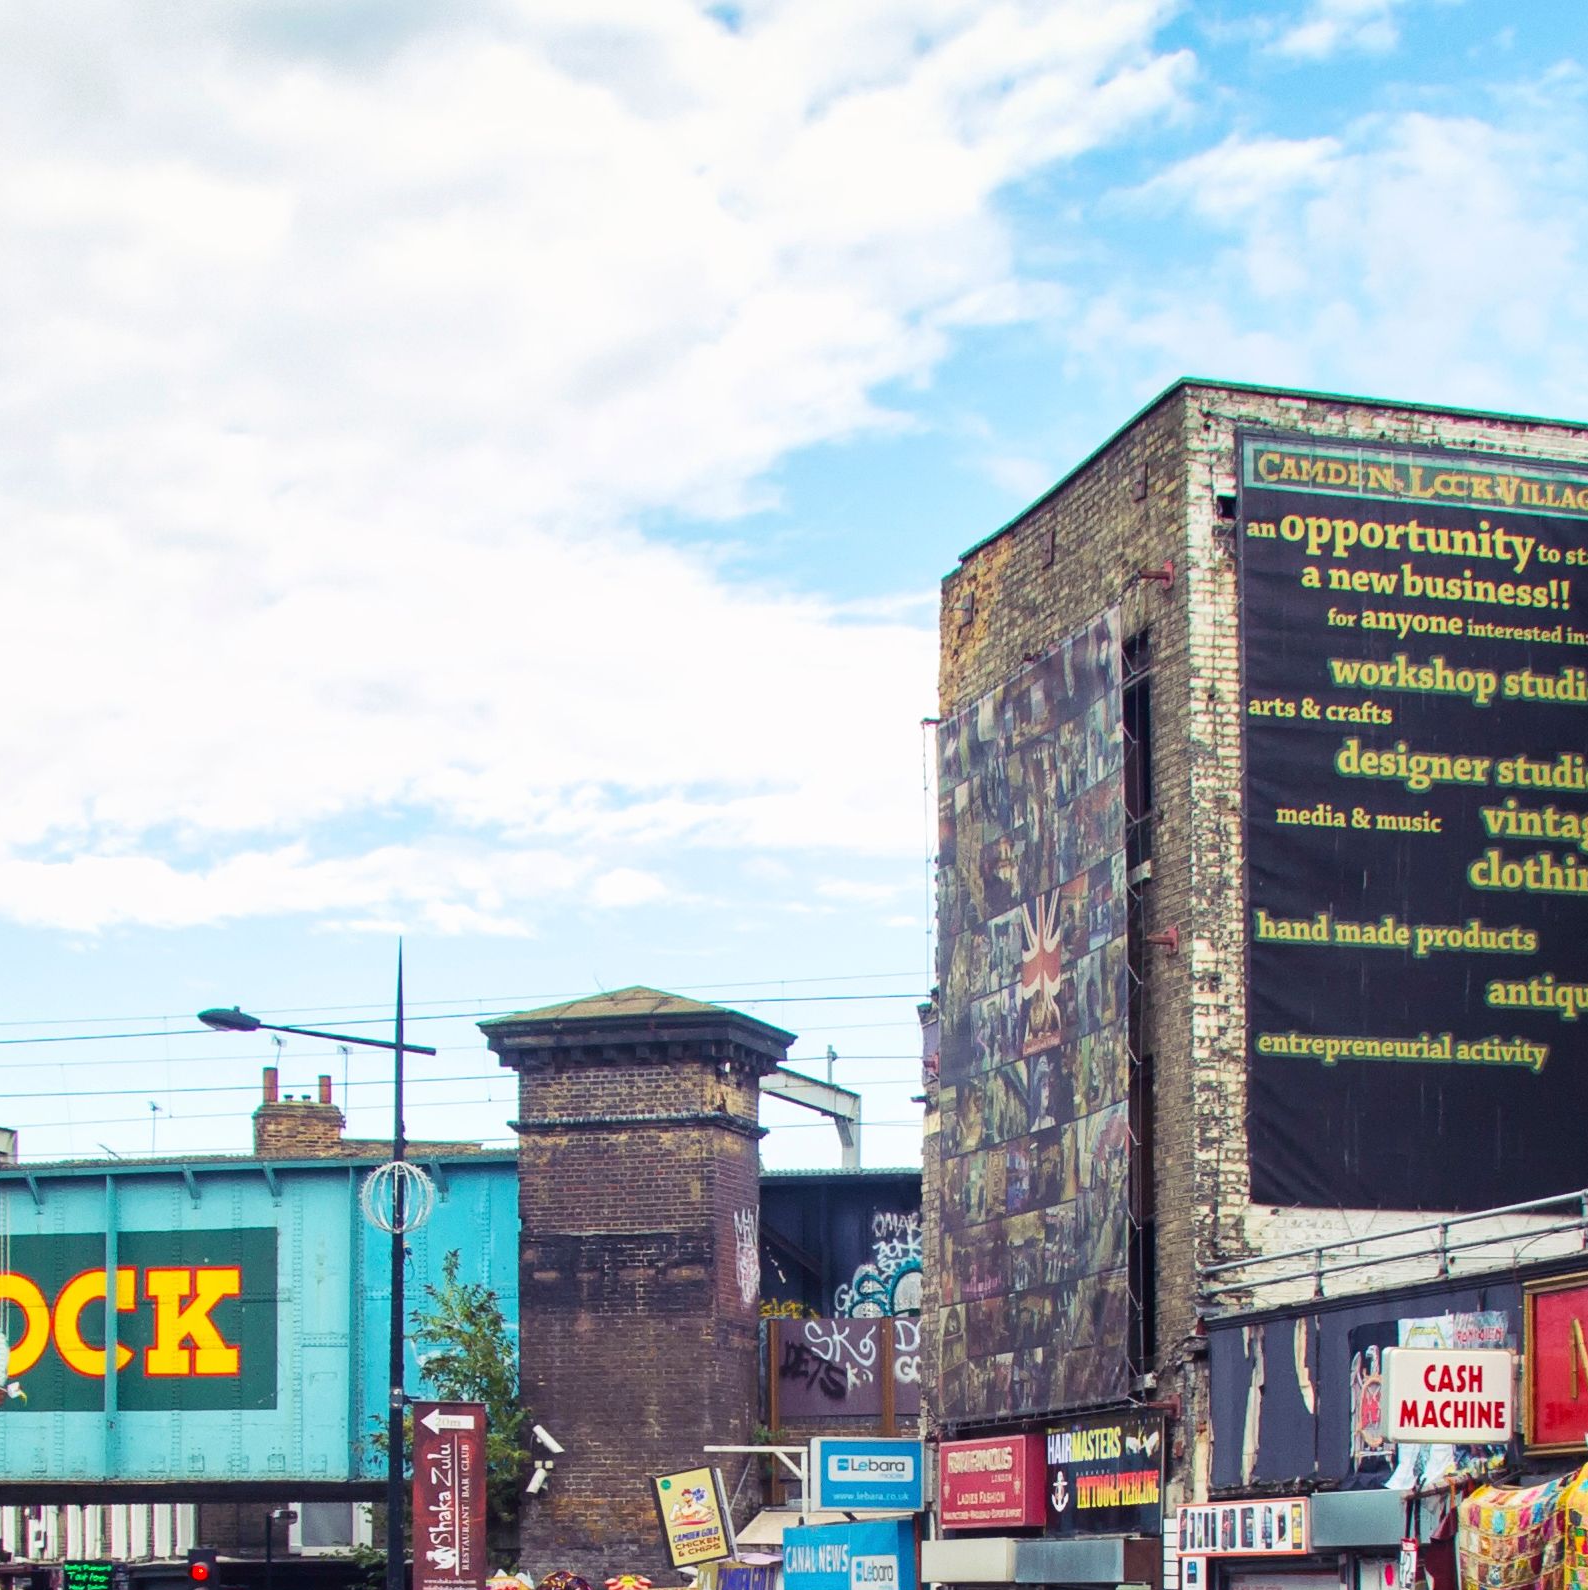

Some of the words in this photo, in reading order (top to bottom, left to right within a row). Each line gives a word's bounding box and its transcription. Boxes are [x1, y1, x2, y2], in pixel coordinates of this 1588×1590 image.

[1258, 450, 1394, 492] CAMDEN
[1411, 465, 1495, 501] LOCK
[1246, 520, 1277, 539] an
[1280, 512, 1535, 574] opportunity
[1538, 545, 1557, 563] to
[1302, 570, 1321, 590] a
[1329, 573, 1397, 595] new
[1404, 565, 1571, 610] business!!
[1327, 608, 1357, 628] for
[1361, 610, 1463, 640] anyone
[1467, 618, 1561, 643] interested
[1332, 655, 1496, 704] workshop
[1248, 698, 1297, 719] arts
[1301, 700, 1320, 719] &
[1325, 701, 1393, 725] crafts
[1337, 741, 1489, 789] designer
[1276, 804, 1346, 828] media
[1351, 808, 1371, 828] &
[1375, 811, 1443, 835] music
[1256, 913, 1330, 943] hand
[1335, 918, 1410, 947] made
[1415, 923, 1537, 955] products
[1258, 1031, 1453, 1065] entrepreneurial
[1456, 1037, 1548, 1071] activity
[1423, 1364, 1483, 1393] CASH
[1399, 1400, 1506, 1429] MACHINE
[461, 1444, 470, 1472] CLUB
[1047, 1427, 1121, 1465] HAIRMASTERS
[426, 1443, 452, 1487] Zulu
[850, 1458, 905, 1472] Lebara
[461, 1477, 470, 1498] BAR
[832, 1491, 909, 1502] www.lebara.co.uk
[979, 1490, 1006, 1504] FASHION
[428, 1490, 454, 1544] Shaka
[461, 1505, 470, 1571] RESTAURANT
[675, 1535, 721, 1550] CHICKEN
[688, 1543, 721, 1555] CHIPS
[785, 1545, 817, 1573] CANAL
[818, 1544, 849, 1573] NEWS
[863, 1560, 893, 1582] Lebara
